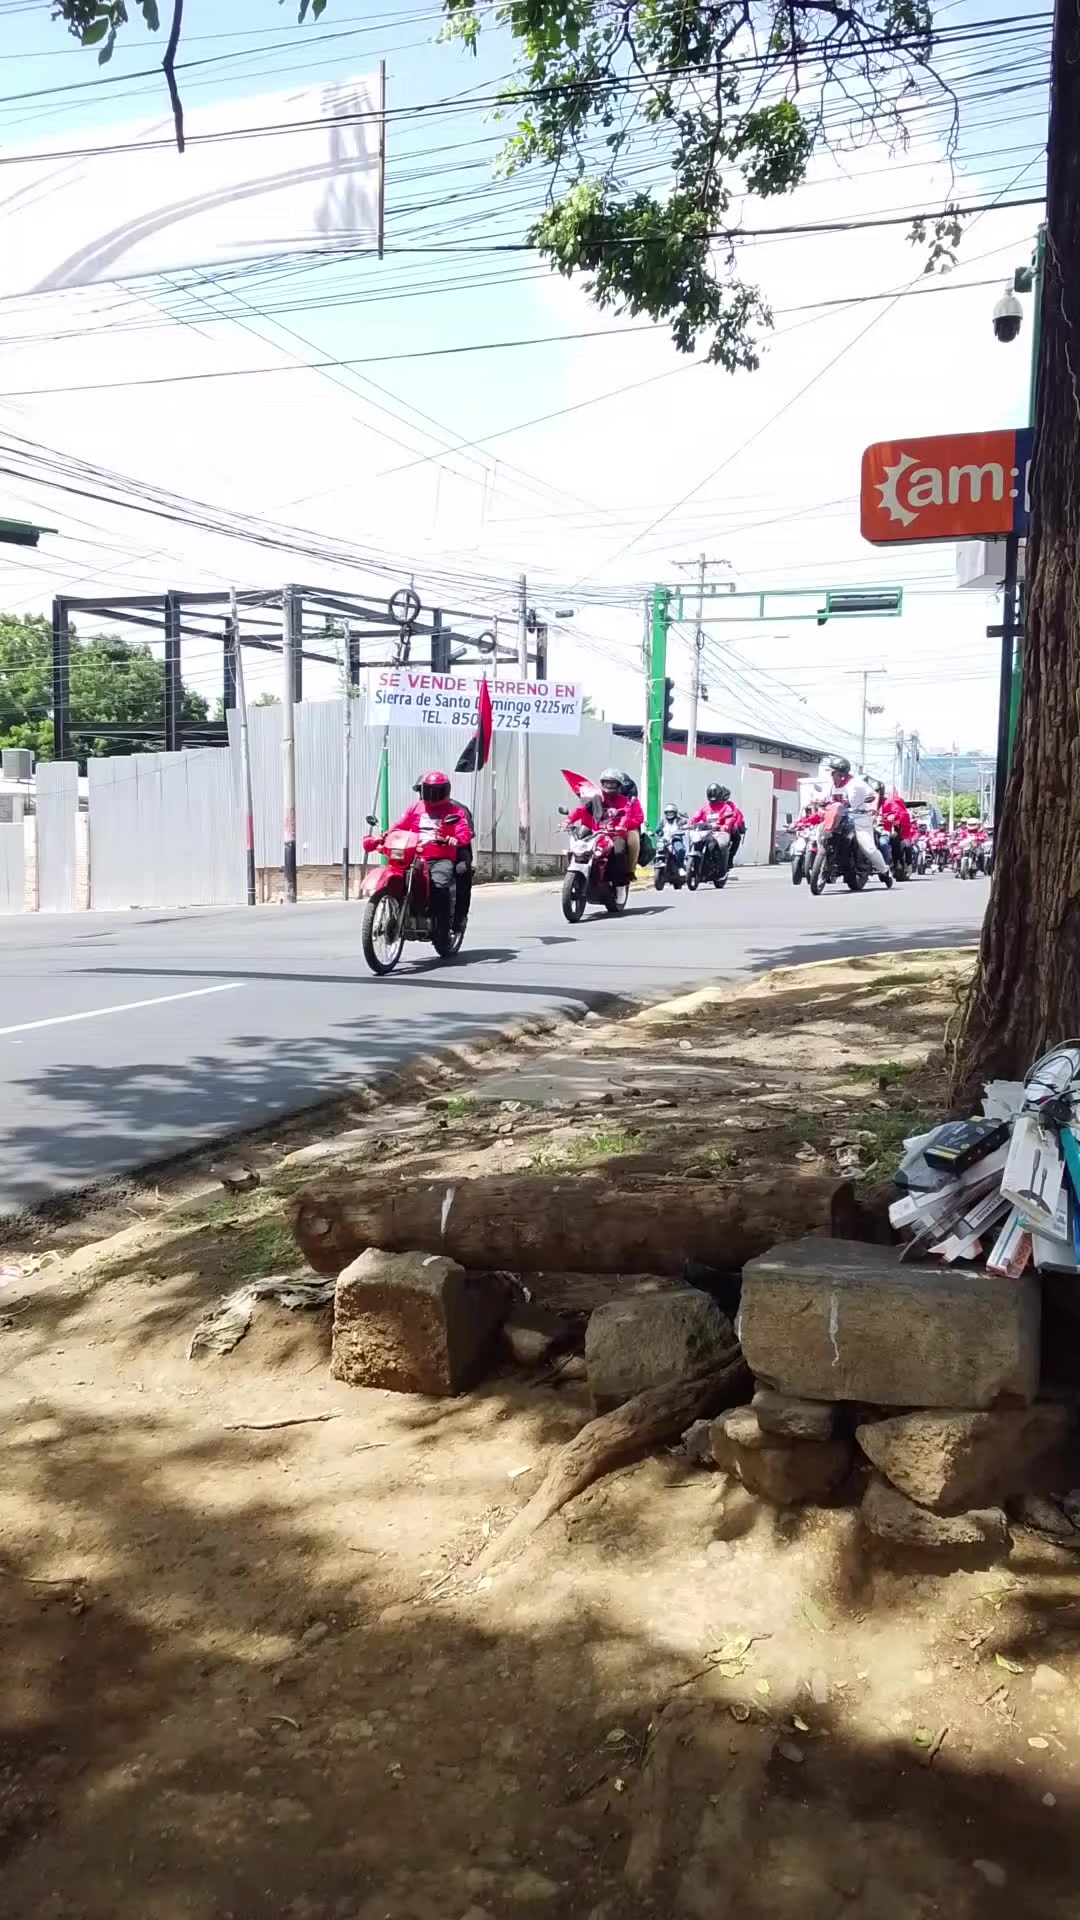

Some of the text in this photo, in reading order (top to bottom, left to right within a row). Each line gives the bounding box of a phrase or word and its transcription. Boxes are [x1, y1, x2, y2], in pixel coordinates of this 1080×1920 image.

[907, 462, 1032, 513] am:
[379, 672, 401, 687] SE
[407, 674, 467, 691] VENDE
[555, 684, 575, 698] EN
[375, 689, 412, 705] Sierra
[416, 692, 431, 706] de
[435, 693, 471, 709] Santo
[474, 696, 531, 715] Dmingo
[534, 699, 561, 714] 9225
[422, 710, 447, 725] TEL.
